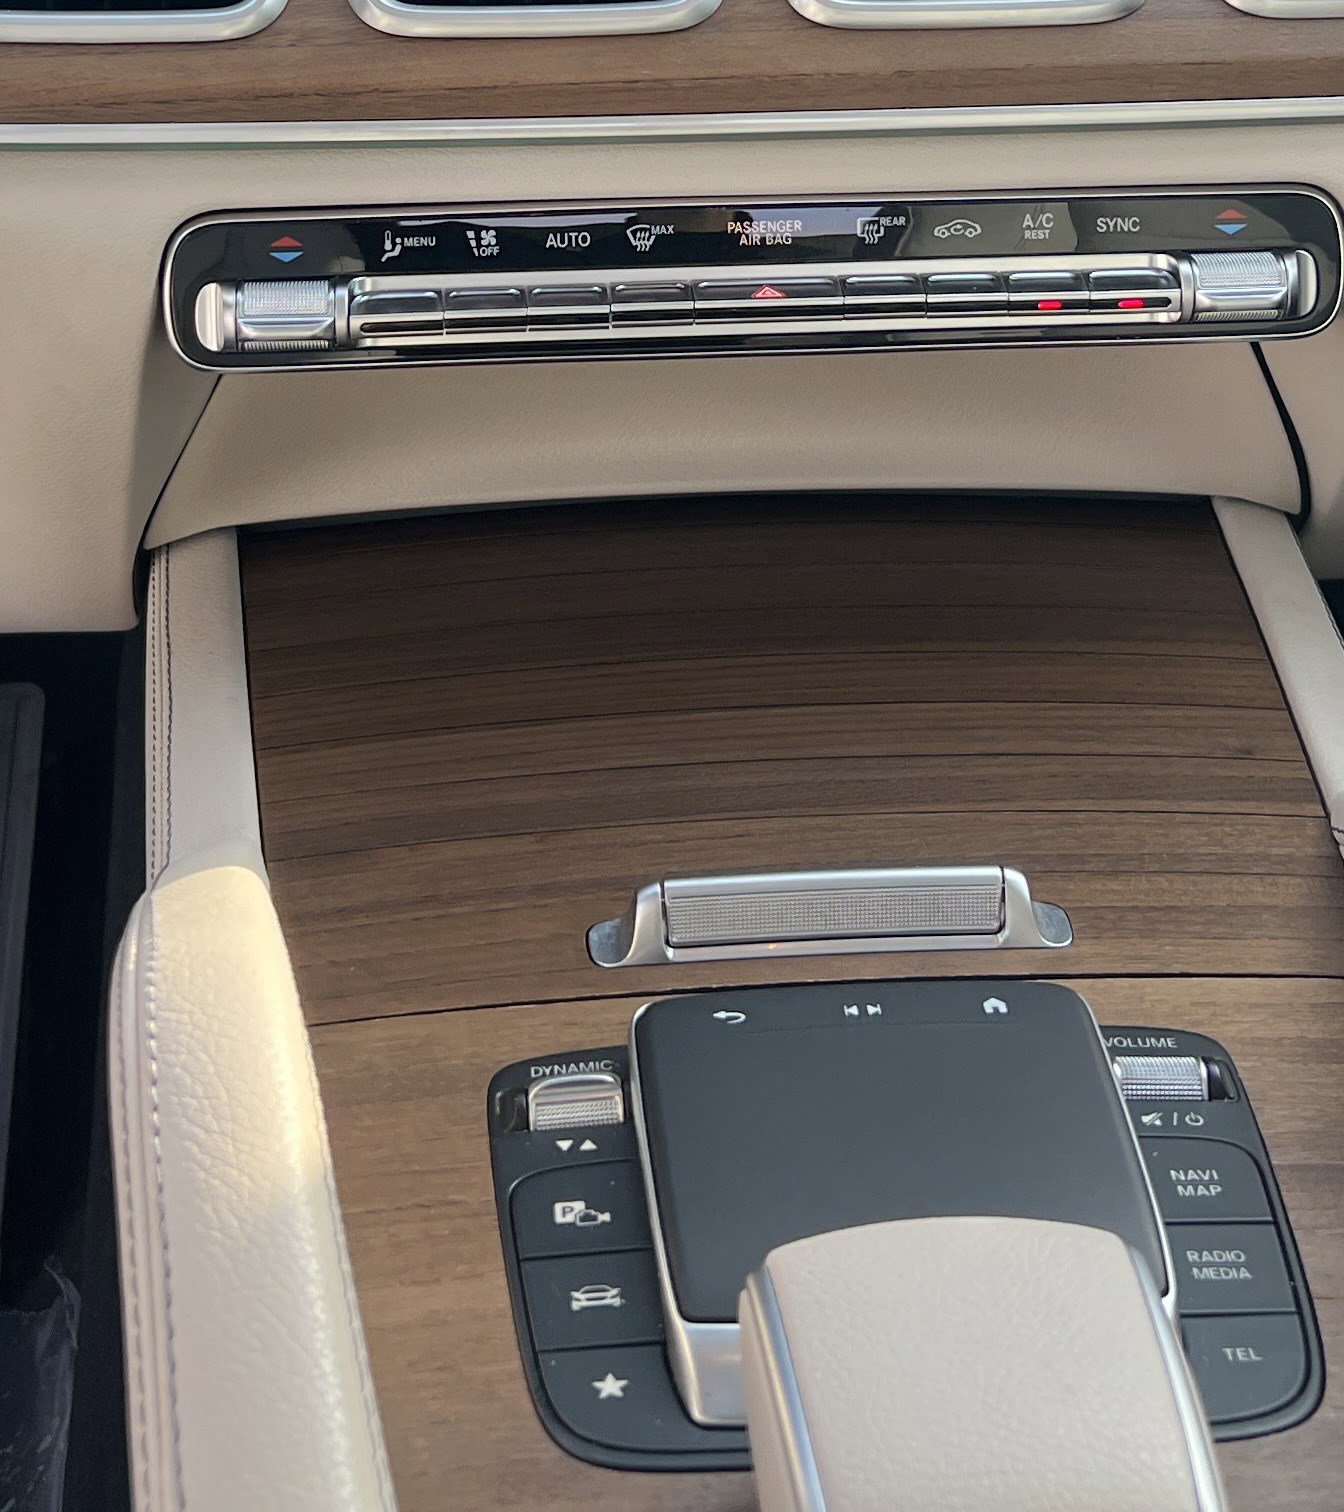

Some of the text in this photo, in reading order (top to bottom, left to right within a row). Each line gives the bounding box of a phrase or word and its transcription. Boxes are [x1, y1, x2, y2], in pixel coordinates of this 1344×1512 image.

[727, 218, 803, 235] PASSENGER
[879, 216, 906, 227] REAR
[1022, 213, 1054, 230] A/C
[1096, 216, 1141, 234] SYNC
[651, 224, 675, 236] MAX
[1024, 229, 1051, 240] REST
[403, 234, 436, 248] MENU
[545, 231, 591, 249] AUTO
[739, 231, 793, 246] AIR BAG
[479, 245, 500, 257] OFF
[1104, 1037, 1177, 1048] VOLUME
[530, 1059, 614, 1078] DYNAMIC
[1169, 1169, 1219, 1181] NAVI
[1176, 1184, 1223, 1197] MAP
[1186, 1249, 1246, 1263] RADIO
[1191, 1267, 1253, 1280] MEDIA
[1222, 1347, 1263, 1361] TEL
